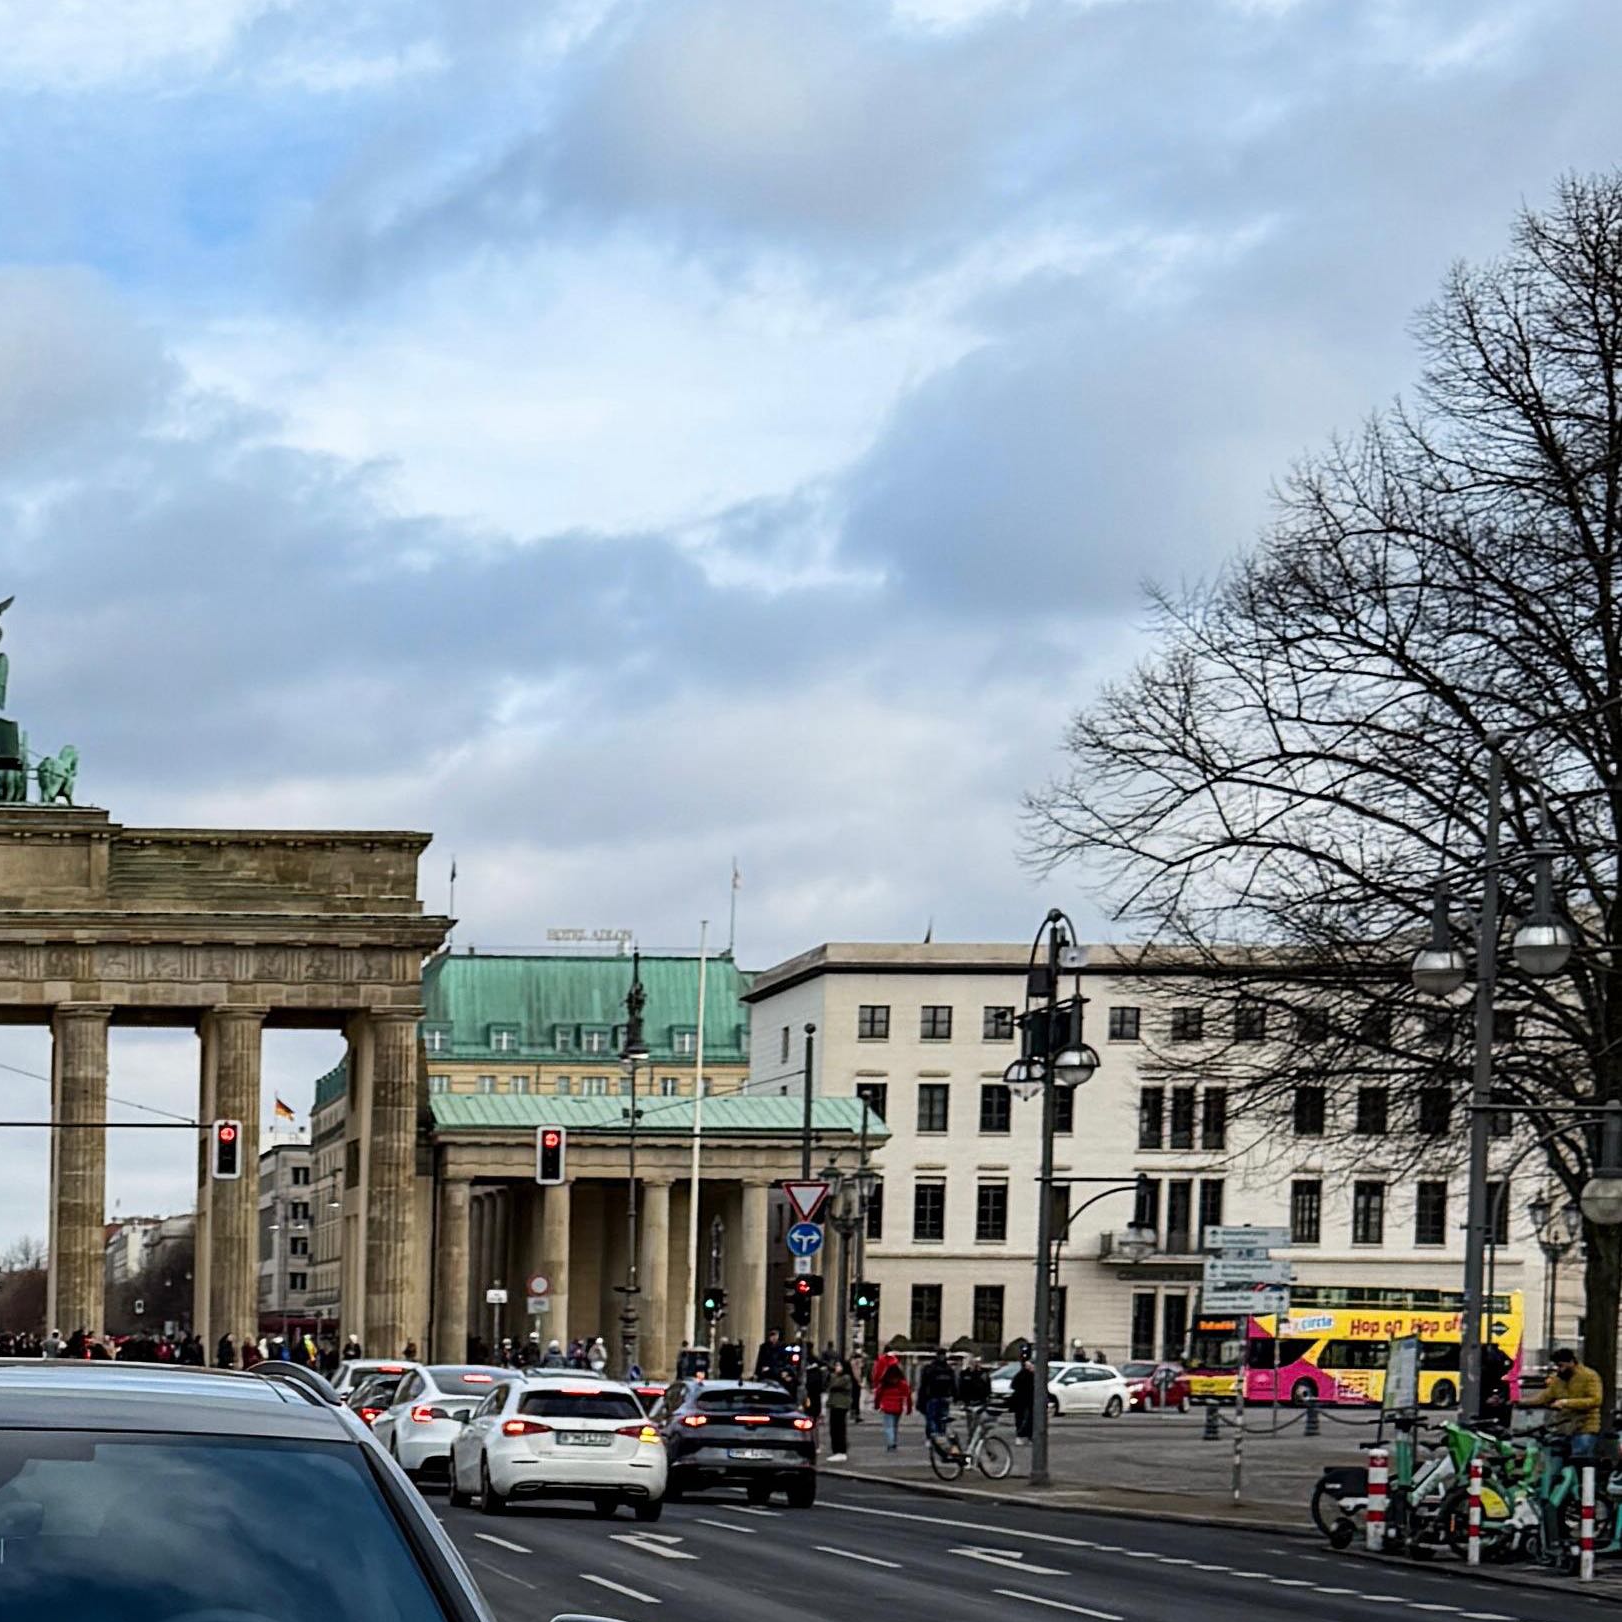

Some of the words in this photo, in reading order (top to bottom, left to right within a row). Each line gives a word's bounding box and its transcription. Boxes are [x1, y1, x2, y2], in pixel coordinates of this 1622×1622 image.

[1350, 1319, 1380, 1337] Hop
[1384, 1319, 1402, 1333] on
[1410, 1318, 1439, 1338] Hop
